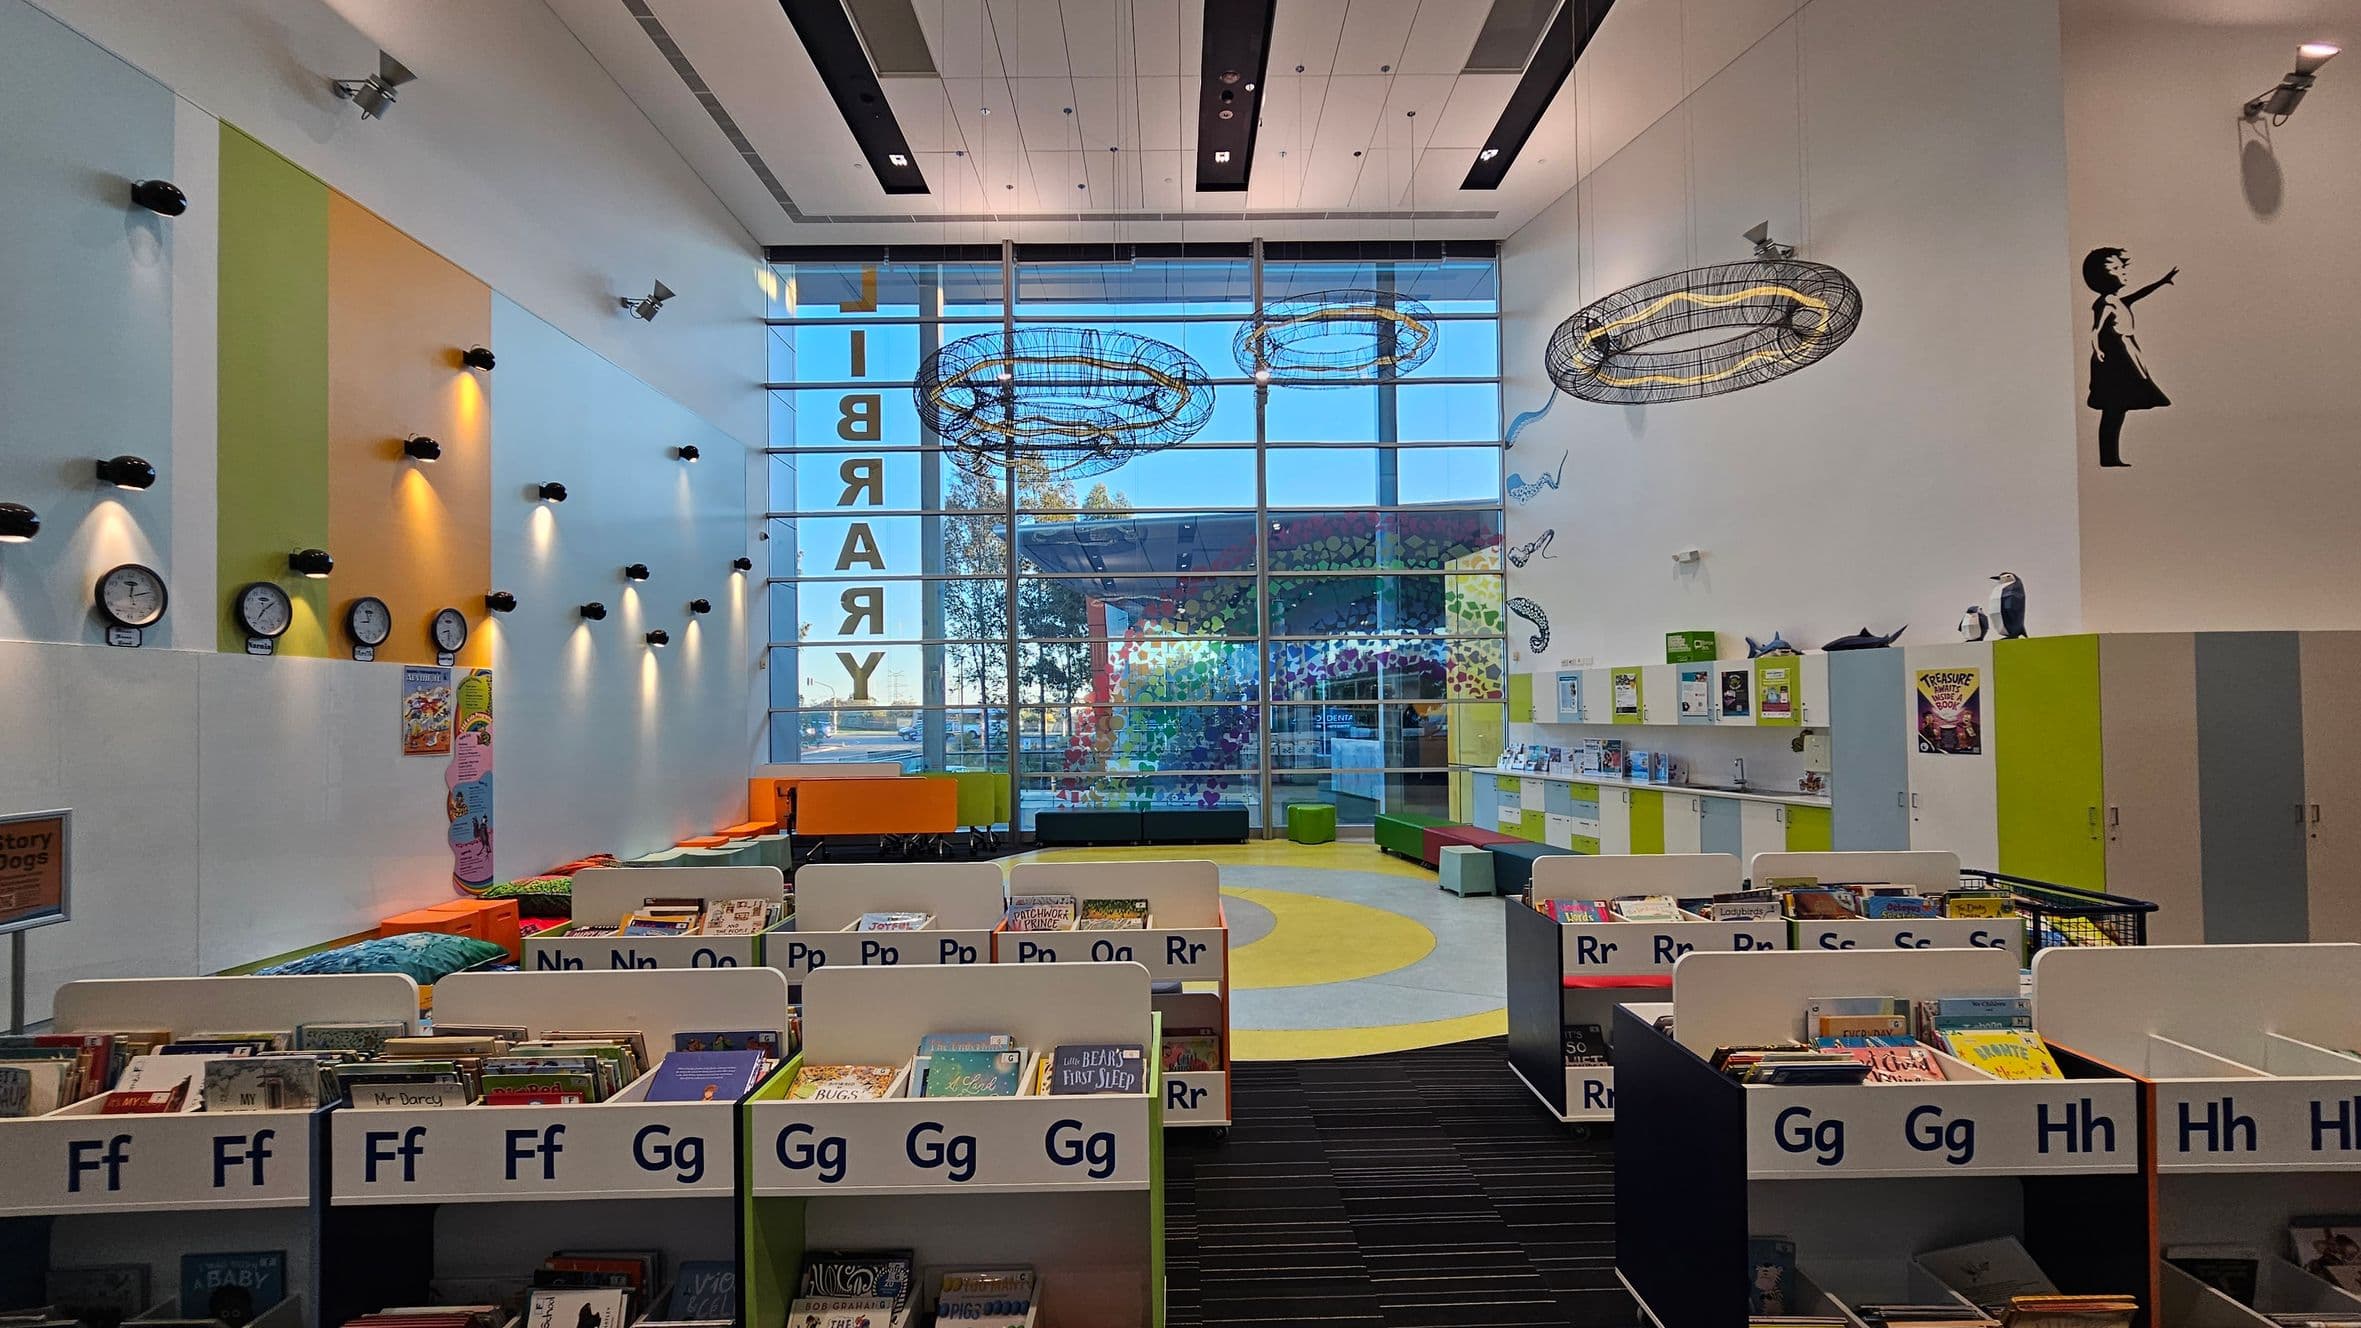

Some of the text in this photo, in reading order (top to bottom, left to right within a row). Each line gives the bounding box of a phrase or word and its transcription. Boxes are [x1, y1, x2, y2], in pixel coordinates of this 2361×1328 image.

[1920, 673, 1975, 688] TREASURE
[1934, 685, 1961, 693] AWAITS
[1932, 693, 1955, 702] INSIDE
[1936, 701, 1960, 710] BOOK
[1014, 908, 1068, 921] PATCHWORK
[1720, 907, 1764, 916] Ladybirds
[868, 922, 913, 931] JOYFUL
[1024, 918, 1060, 929] PRINCE
[537, 950, 583, 971] Nn
[611, 950, 657, 970] Nn
[788, 942, 825, 973] Pp
[861, 940, 898, 963] Pp
[939, 938, 976, 961] Pp
[1166, 935, 1206, 964] Rr
[1577, 935, 1617, 964] Rr
[1654, 935, 1694, 964] Rr
[1007, 1054, 1014, 1062] G
[1063, 1048, 1124, 1068] Little BEAR'S
[1566, 1041, 1587, 1054] SO
[1974, 1043, 2029, 1065] BRONTE
[962, 1073, 998, 1094] Land
[1063, 1068, 1135, 1090] FIRST SLEEP
[240, 1093, 256, 1105] MY
[374, 1092, 444, 1107] Mr Darcy
[815, 1089, 859, 1100] BUGS
[1168, 1081, 1207, 1109] Rr
[1905, 1105, 1975, 1165] Gg
[2037, 1098, 2115, 1154] Hh
[2178, 1097, 2257, 1152] Hh
[1774, 1106, 1845, 1166] Gg
[213, 1129, 275, 1188] Ff
[365, 1126, 427, 1183] Ff
[505, 1124, 566, 1180] Ff
[633, 1124, 705, 1184] Gg
[776, 1122, 847, 1183] Gg
[906, 1122, 976, 1182] Gg
[1044, 1118, 1116, 1179] Gg
[67, 1134, 133, 1193] Ff
[207, 1269, 271, 1289] BABY
[806, 1303, 828, 1311] BOB
[950, 1303, 982, 1320] PIGS
